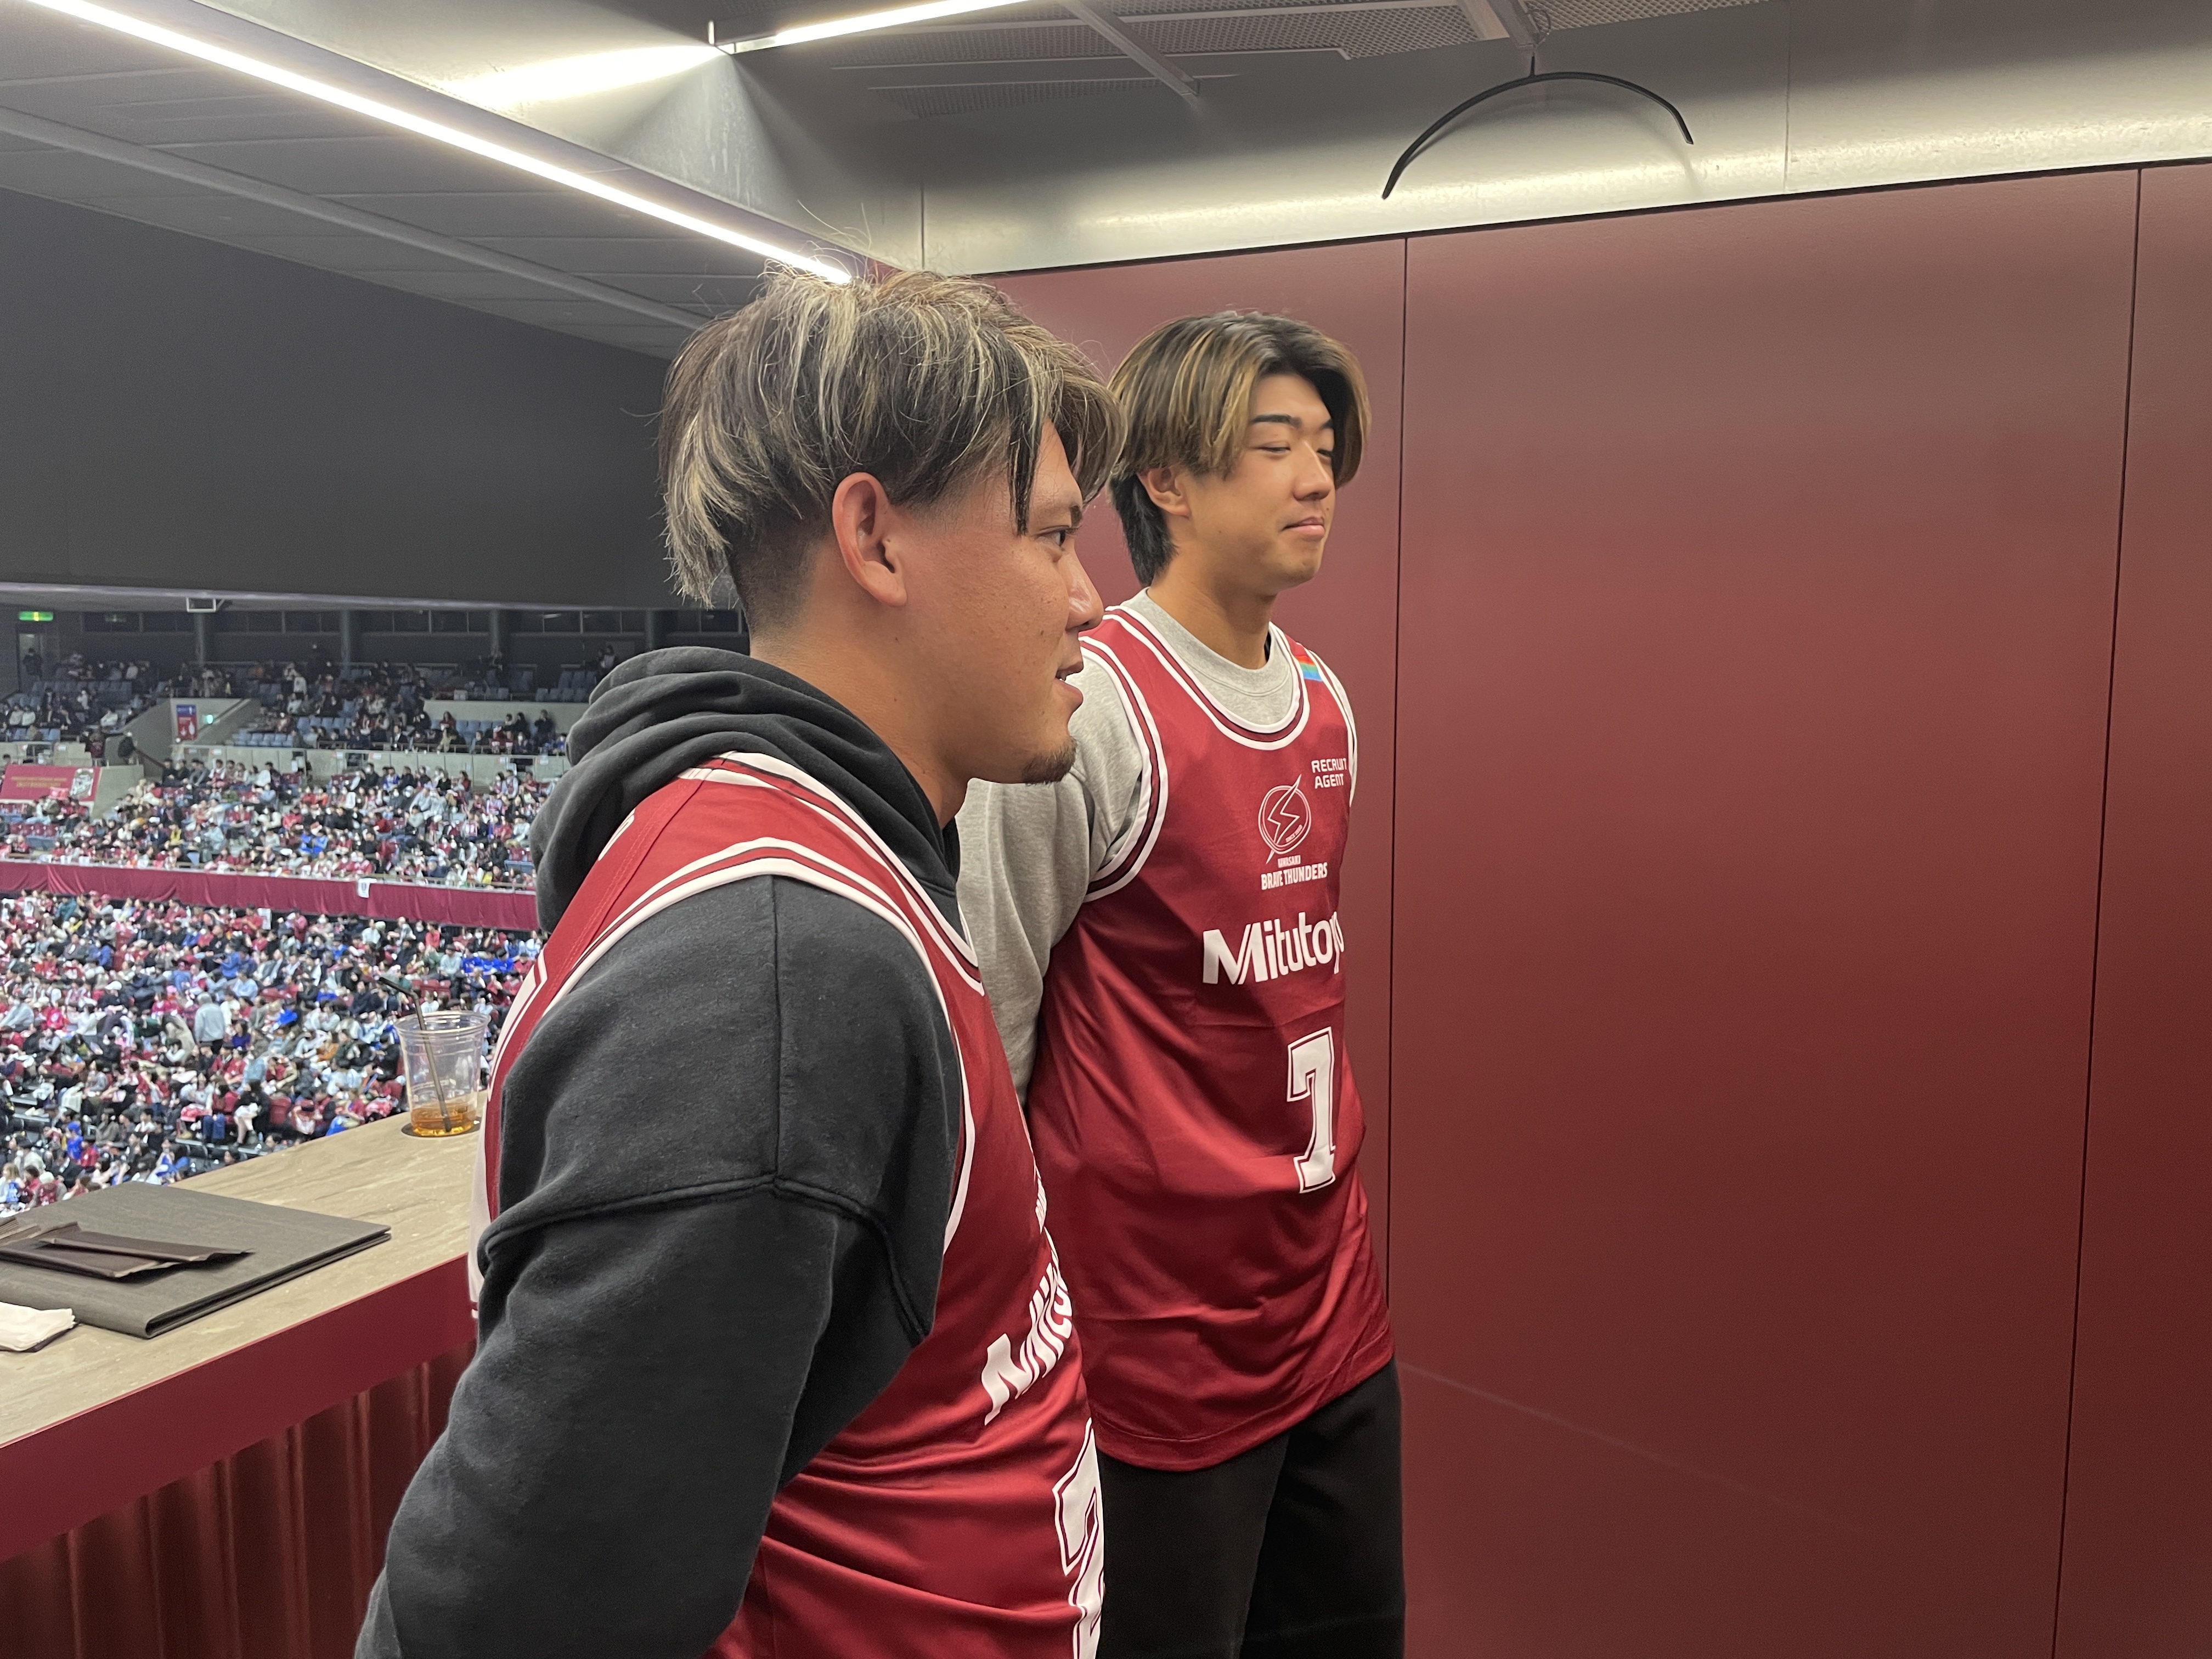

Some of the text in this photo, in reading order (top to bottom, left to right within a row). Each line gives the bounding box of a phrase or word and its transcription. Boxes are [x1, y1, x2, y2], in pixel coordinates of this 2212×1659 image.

[1311, 758, 1347, 774] RECRUIT
[1314, 773, 1344, 789] AGENT
[1261, 862, 1328, 890] BRAVE THUNDERS
[1286, 1026, 1336, 1194] 7
